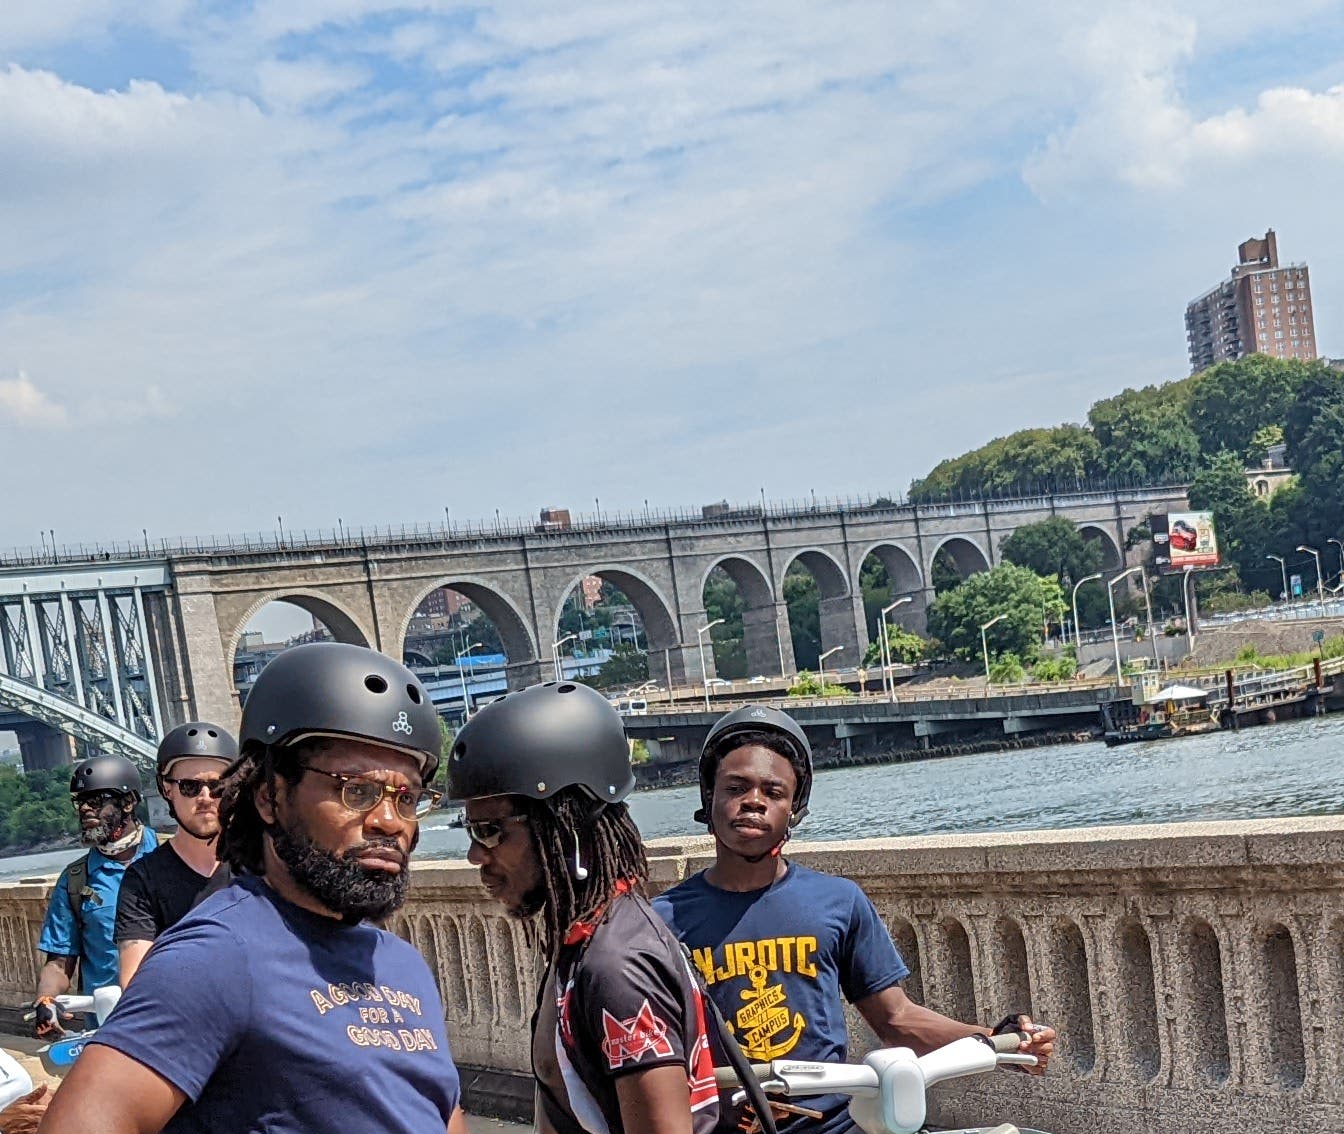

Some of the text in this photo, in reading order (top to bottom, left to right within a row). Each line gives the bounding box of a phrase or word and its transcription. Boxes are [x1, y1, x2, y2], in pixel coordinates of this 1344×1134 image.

[693, 936, 817, 985] NJROTC
[310, 982, 422, 1015] A GOOD DAY
[739, 990, 779, 1024] GRAPHICS
[359, 1007, 404, 1023] FOR A
[751, 1013, 787, 1043] CAMPUS
[347, 1025, 438, 1052] GOOD DAY
